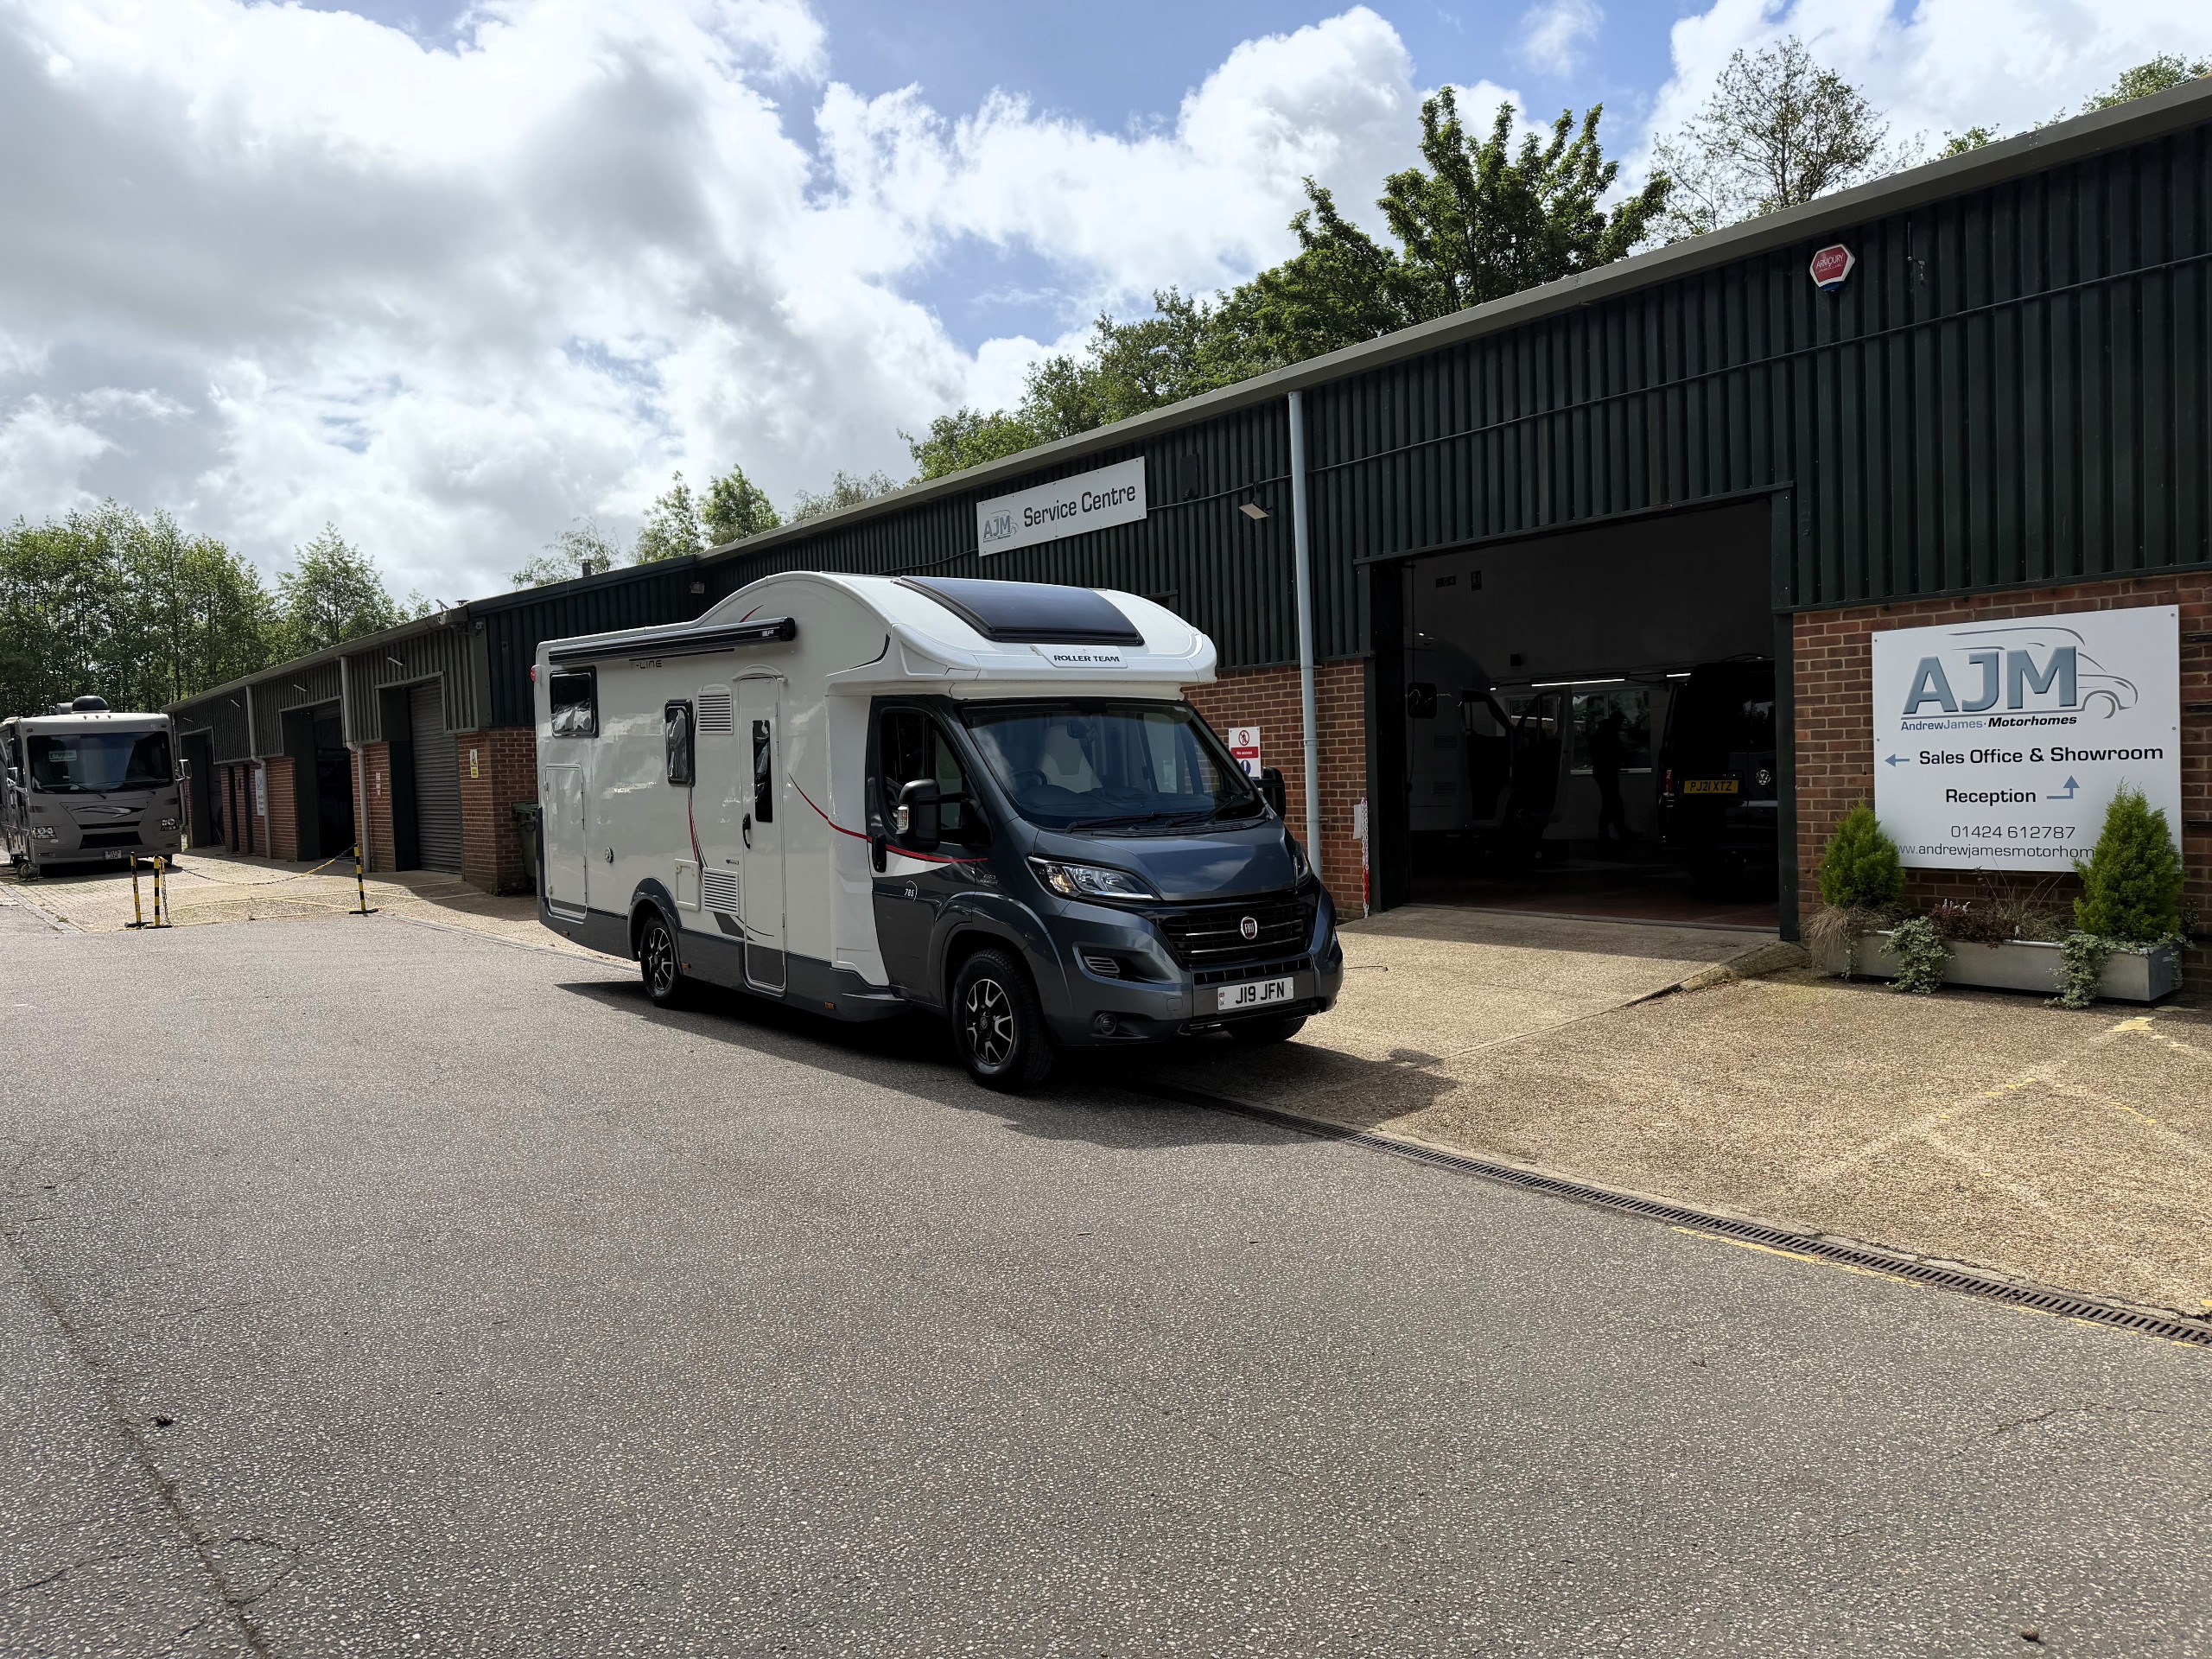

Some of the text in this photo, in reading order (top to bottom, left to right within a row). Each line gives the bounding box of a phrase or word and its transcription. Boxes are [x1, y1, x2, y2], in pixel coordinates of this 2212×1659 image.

[1024, 486, 1135, 527] Service Centre
[983, 515, 1010, 538] AJM
[1903, 645, 2077, 715] AJM
[1919, 747, 2164, 765] Sales Office & Showroom
[1690, 781, 1732, 791] PJ21 XTZ
[1945, 789, 2037, 806] Reception
[1951, 825, 2075, 839] 01424 612787
[1896, 843, 2094, 858] ww.andrewjamesmotorhom
[1236, 982, 1285, 1004] J19 JFN
